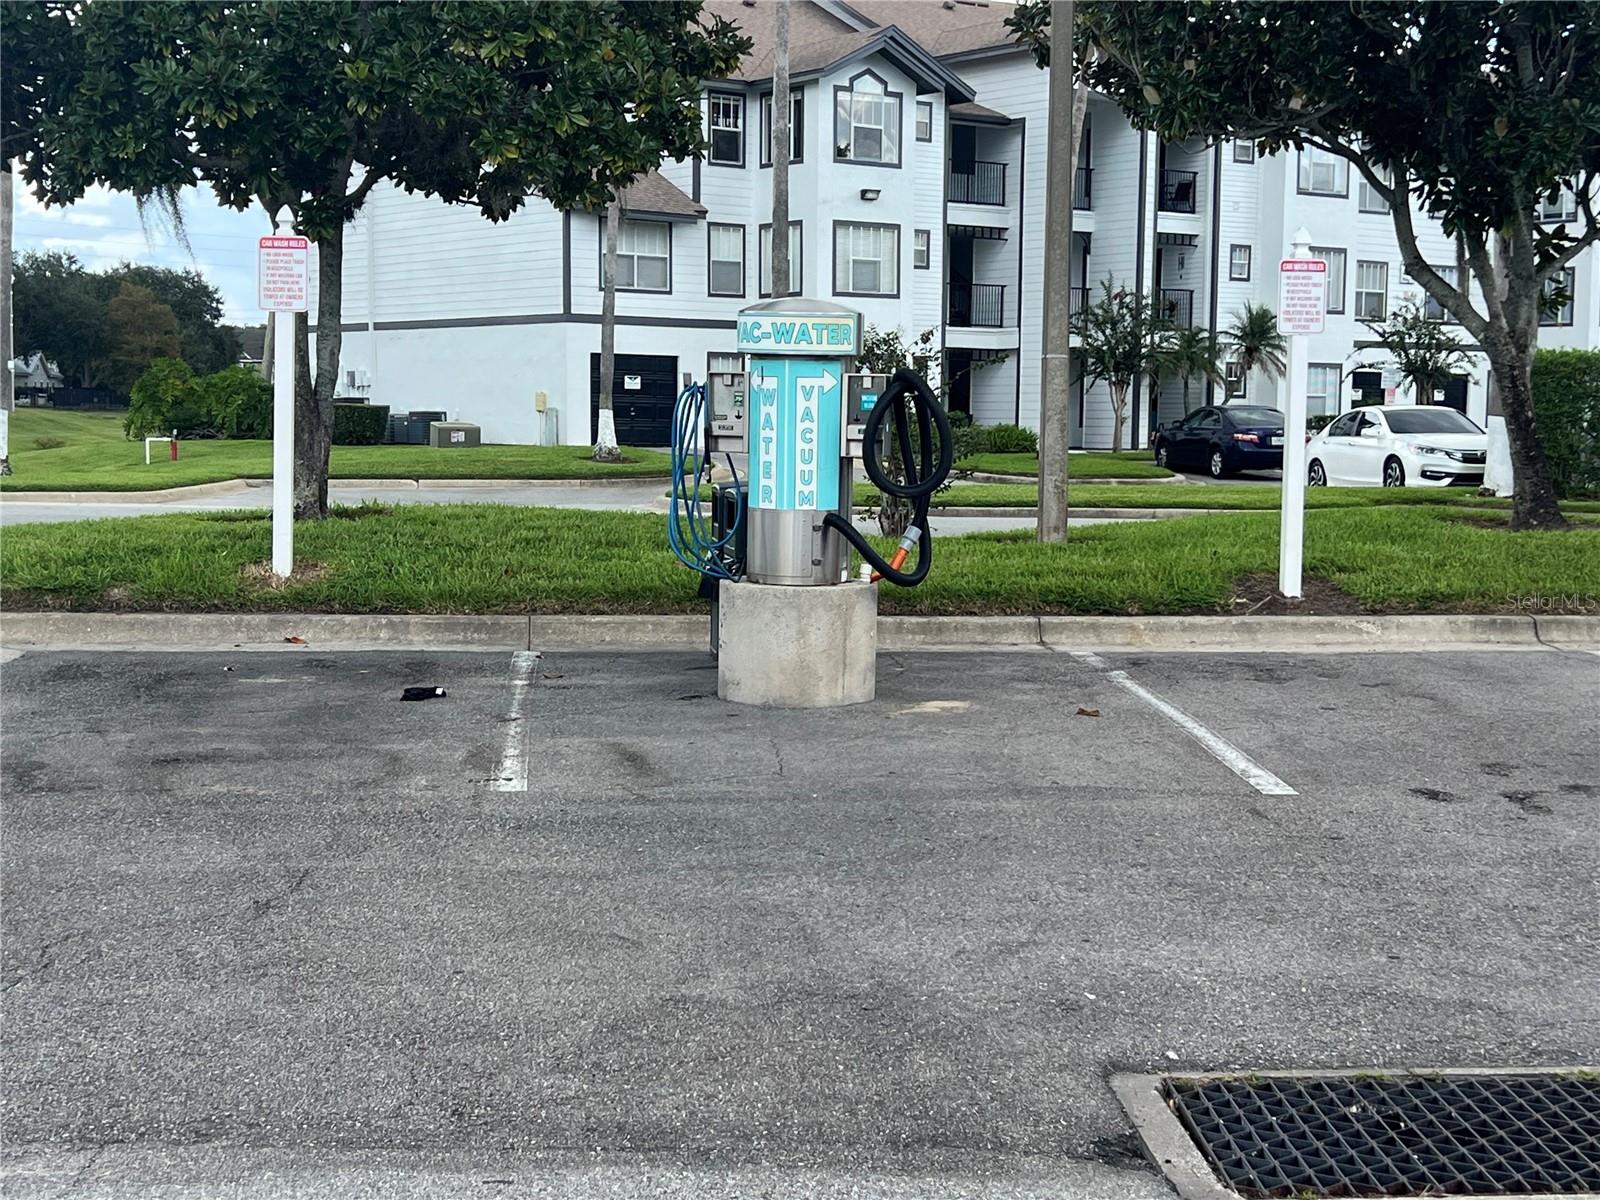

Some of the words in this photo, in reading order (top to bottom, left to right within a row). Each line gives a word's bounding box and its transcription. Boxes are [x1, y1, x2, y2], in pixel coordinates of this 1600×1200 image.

[738, 322, 852, 345] AC-WATER
[762, 388, 776, 504] WATER
[798, 386, 814, 506] VACUUM
